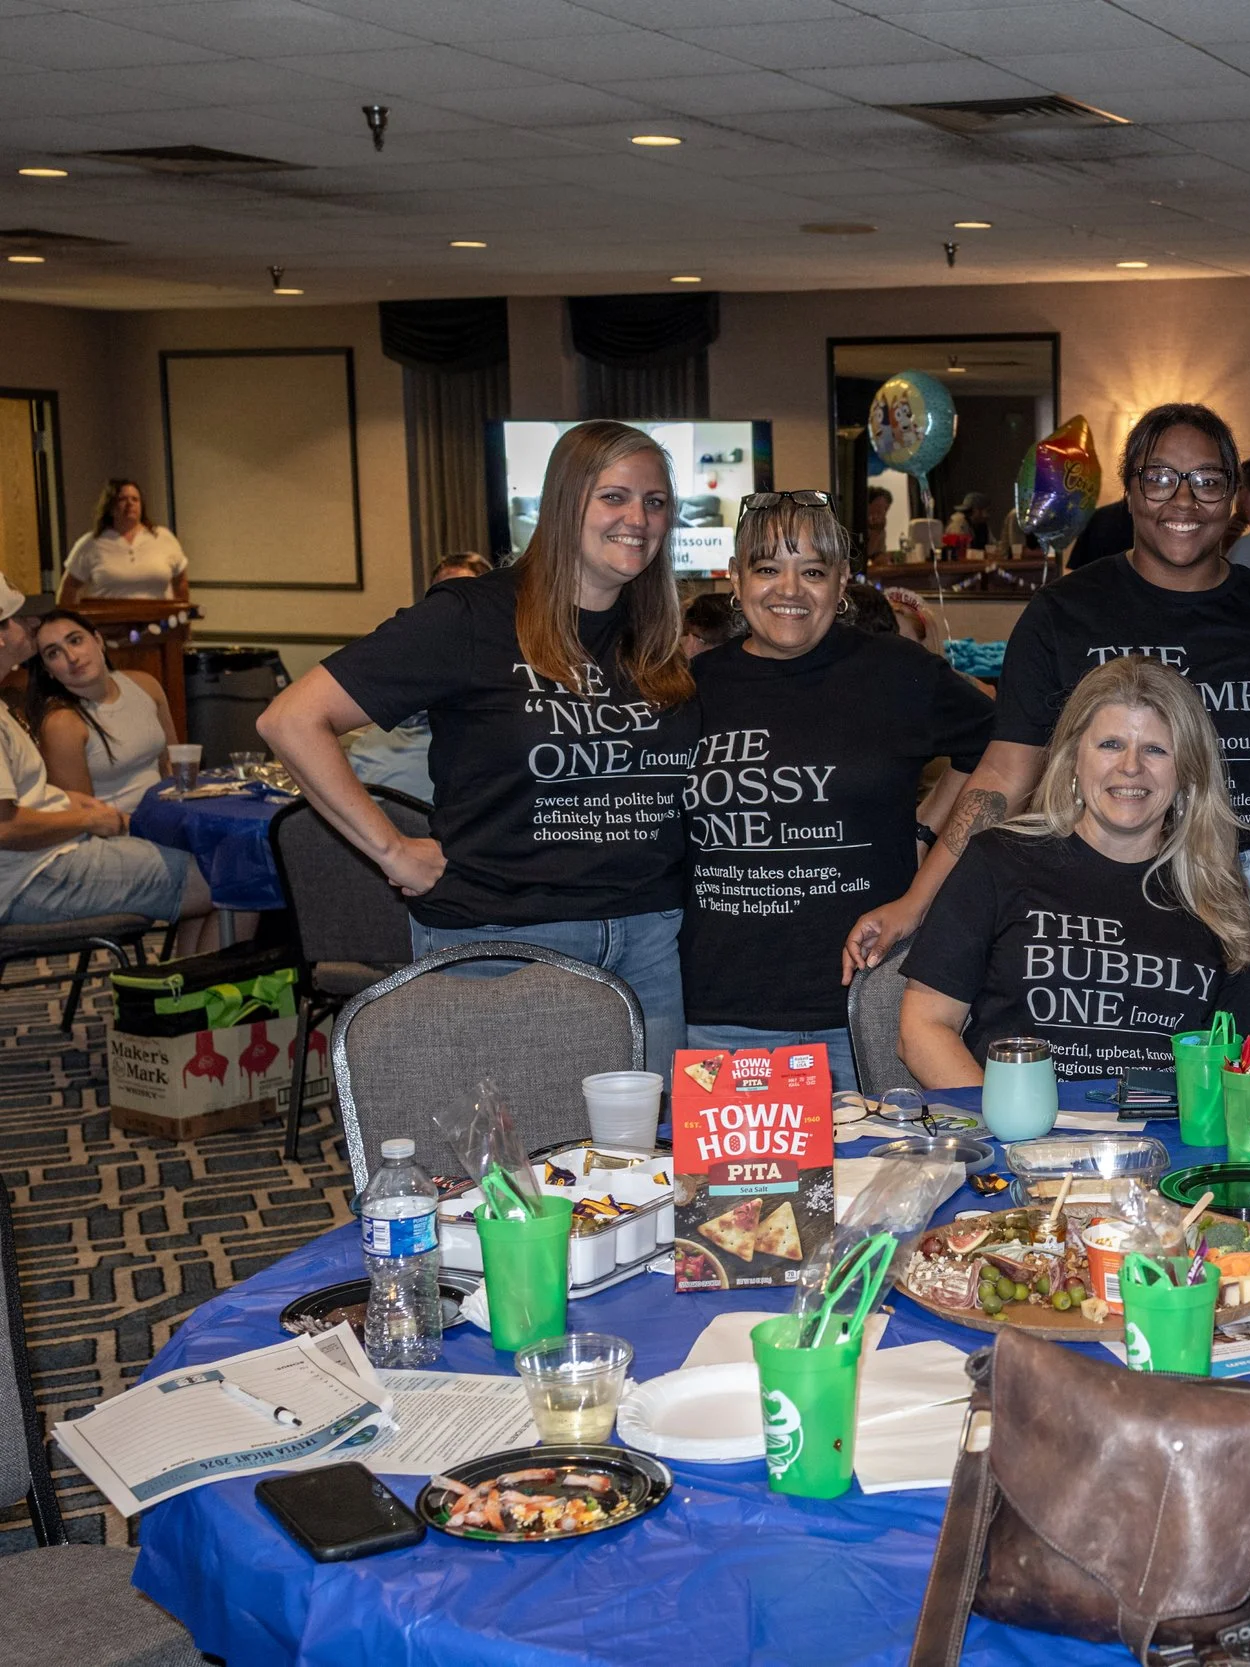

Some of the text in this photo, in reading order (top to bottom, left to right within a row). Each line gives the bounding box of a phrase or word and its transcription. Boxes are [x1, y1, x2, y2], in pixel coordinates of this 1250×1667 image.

[674, 536, 722, 546] issouri
[690, 729, 770, 769] THE
[528, 740, 691, 779] ONE [noun]
[682, 766, 836, 810] BOSSY
[534, 791, 674, 809] sweet and polite but
[533, 810, 602, 827] definitely
[606, 811, 632, 823] has
[533, 828, 602, 843] choosing
[606, 829, 630, 841] not
[634, 828, 647, 840] to
[690, 812, 843, 847] ONE [noun]
[694, 865, 841, 881] Naturally takes charge,
[695, 878, 870, 897] gives instructions, and calls
[699, 897, 706, 909] it
[1025, 910, 1125, 945] THE
[1022, 945, 1216, 1002] BUBBLY
[1026, 987, 1124, 1026] ONE
[1047, 1040, 1091, 1059] heerful,
[1096, 1045, 1145, 1060] upbeat,
[732, 1058, 770, 1069] TOWN
[1053, 1061, 1102, 1075] tagious
[126, 1062, 168, 1085] Mark
[731, 1068, 773, 1079] HOUSE
[743, 1079, 763, 1087] PITA
[684, 1104, 820, 1133] EST. TOWN 1940
[697, 1130, 809, 1161] HOUSE
[727, 1163, 782, 1181] PITA
[276, 1438, 317, 1454] TRIVIA
[200, 1460, 231, 1470] 2026
[235, 1450, 273, 1463] NIGHT
